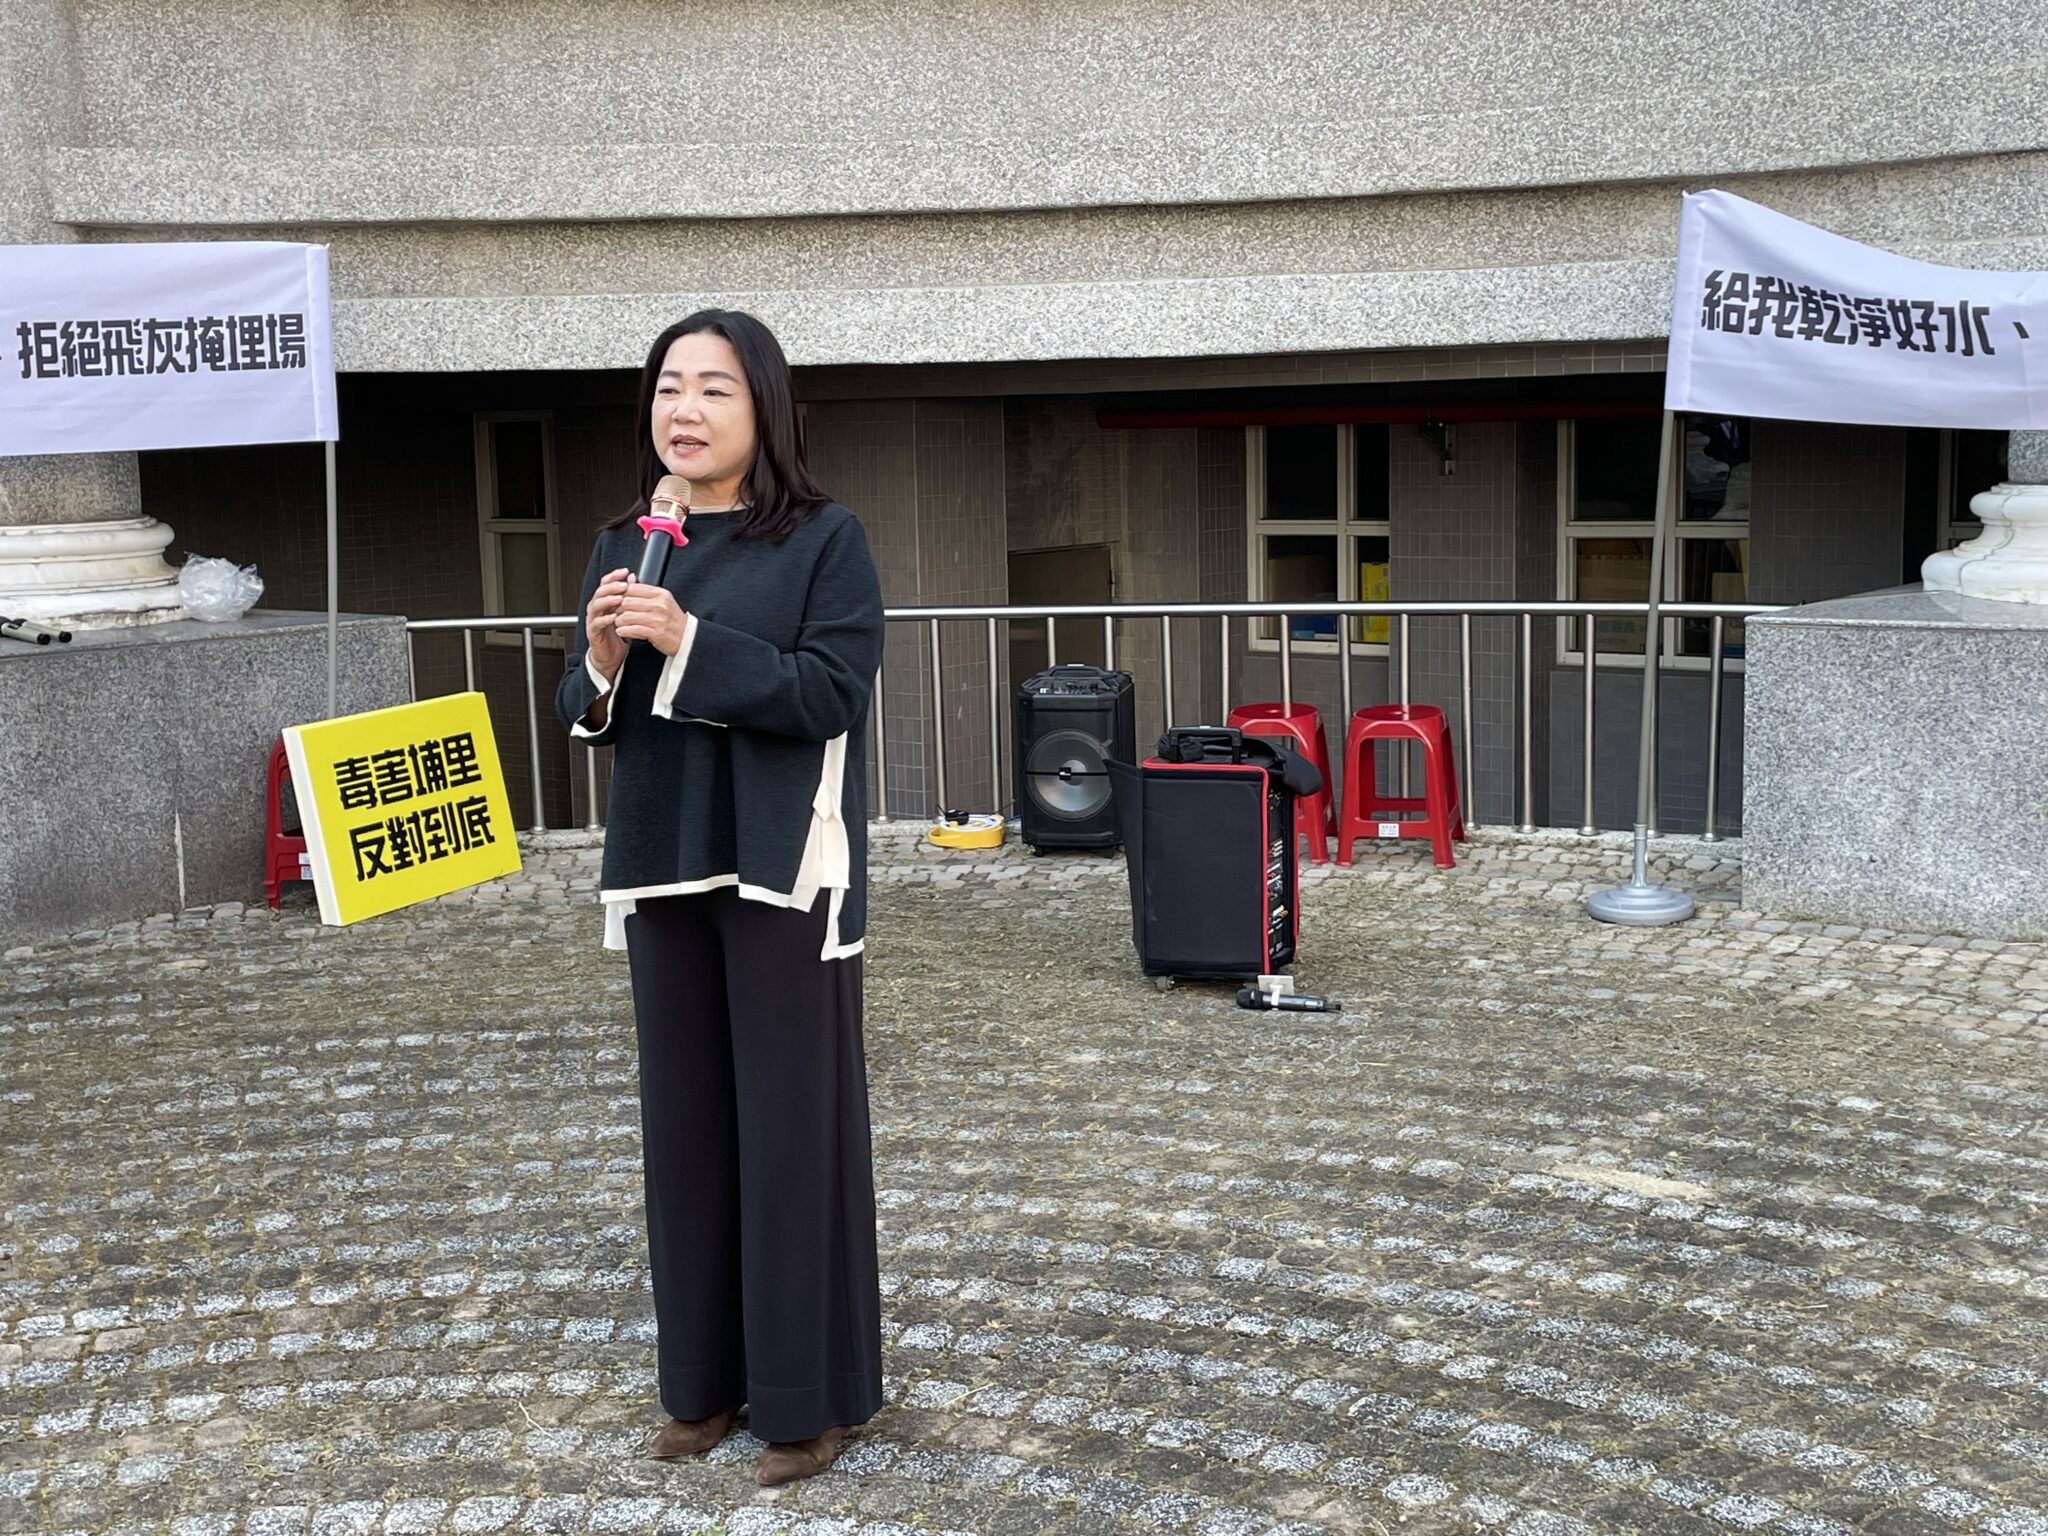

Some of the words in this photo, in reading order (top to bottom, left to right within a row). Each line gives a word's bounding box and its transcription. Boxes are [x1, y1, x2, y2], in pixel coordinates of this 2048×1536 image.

[333, 732, 482, 810] 毒害埔里
[349, 795, 496, 882] 反對到底
